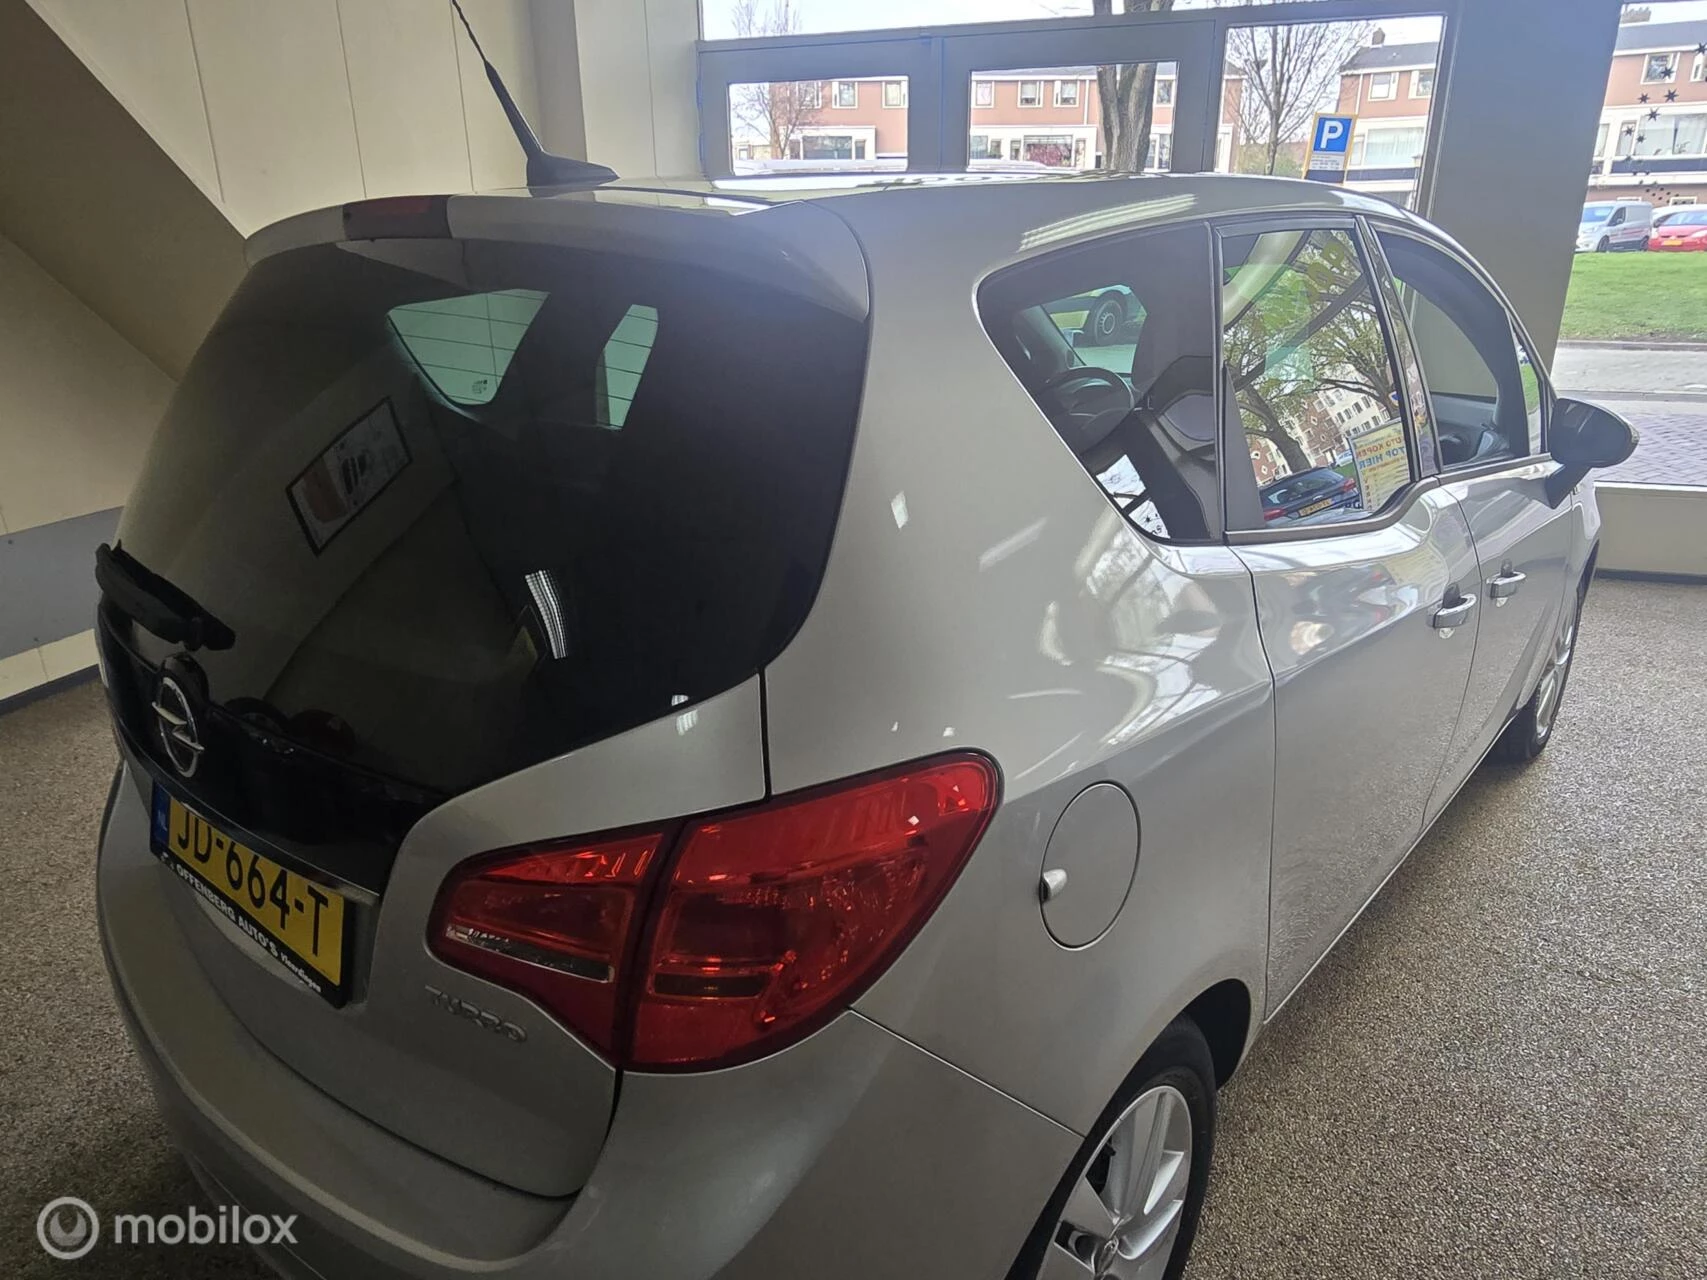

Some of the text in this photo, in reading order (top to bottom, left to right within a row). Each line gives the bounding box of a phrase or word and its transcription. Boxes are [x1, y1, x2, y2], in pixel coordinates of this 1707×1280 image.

[1320, 120, 1344, 149] P
[176, 863, 236, 922] OFFENBERG
[238, 915, 279, 958] AUTO'S
[178, 810, 329, 957] JD-664-T
[424, 984, 527, 1042] TURBO
